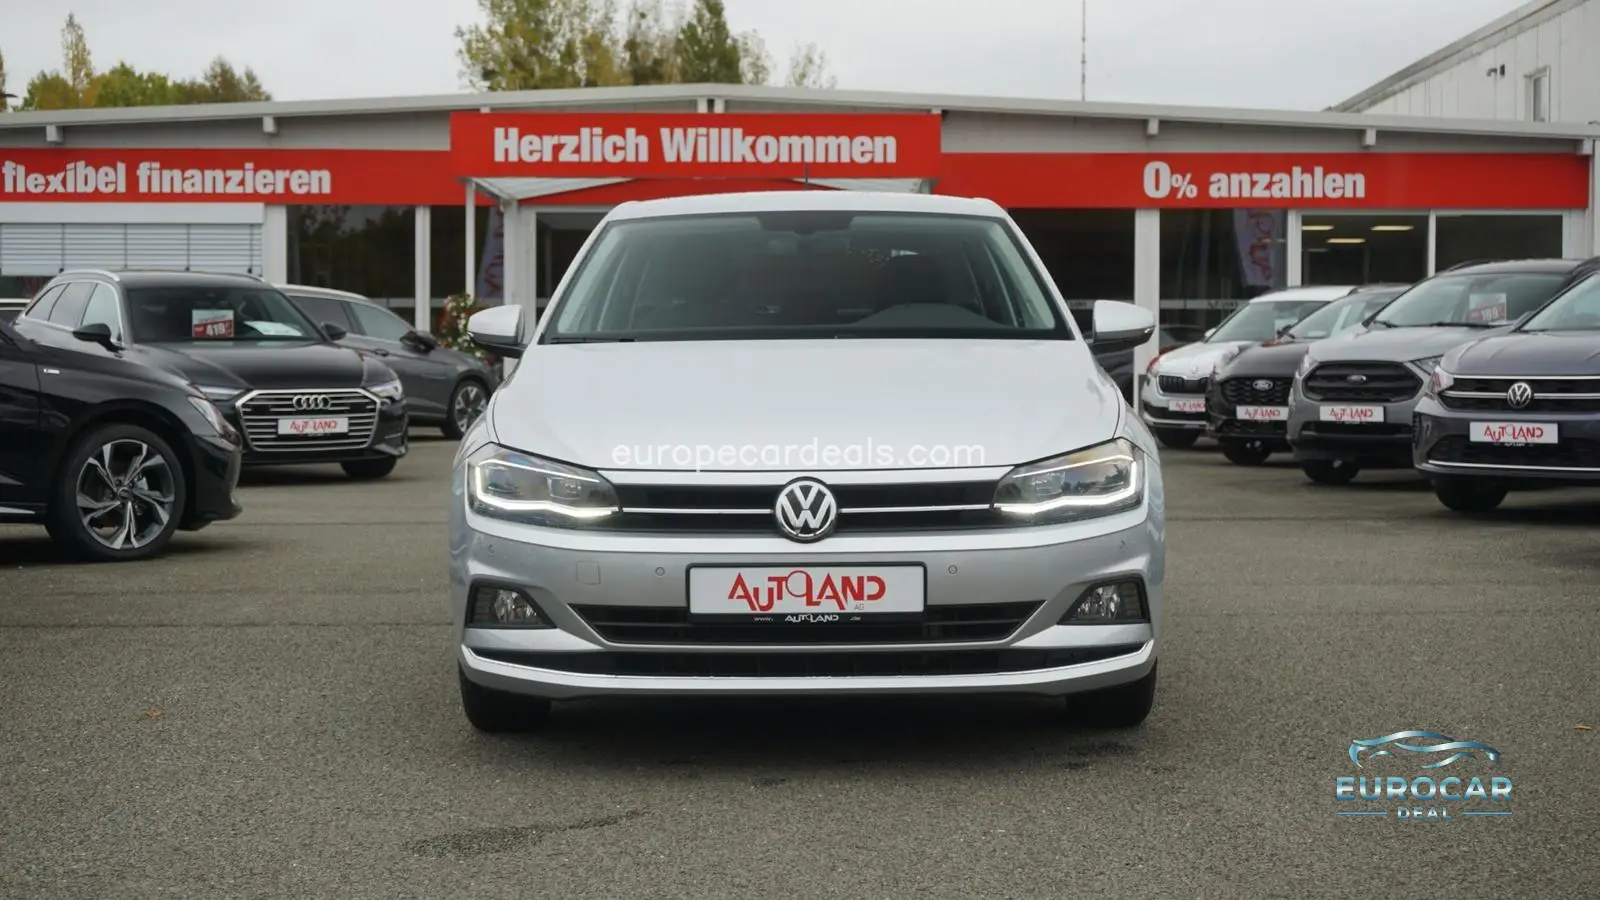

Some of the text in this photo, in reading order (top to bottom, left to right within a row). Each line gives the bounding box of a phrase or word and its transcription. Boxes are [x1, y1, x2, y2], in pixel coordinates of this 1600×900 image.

[493, 127, 898, 164] Herzlich Willkommen
[2, 160, 332, 196] flexibel finanzieren
[1143, 161, 1366, 199] 0% anzahlen
[1483, 422, 1544, 441] AUTOLAND
[727, 567, 888, 613] AUTOLAND
[784, 612, 840, 623] AUTOLAND
